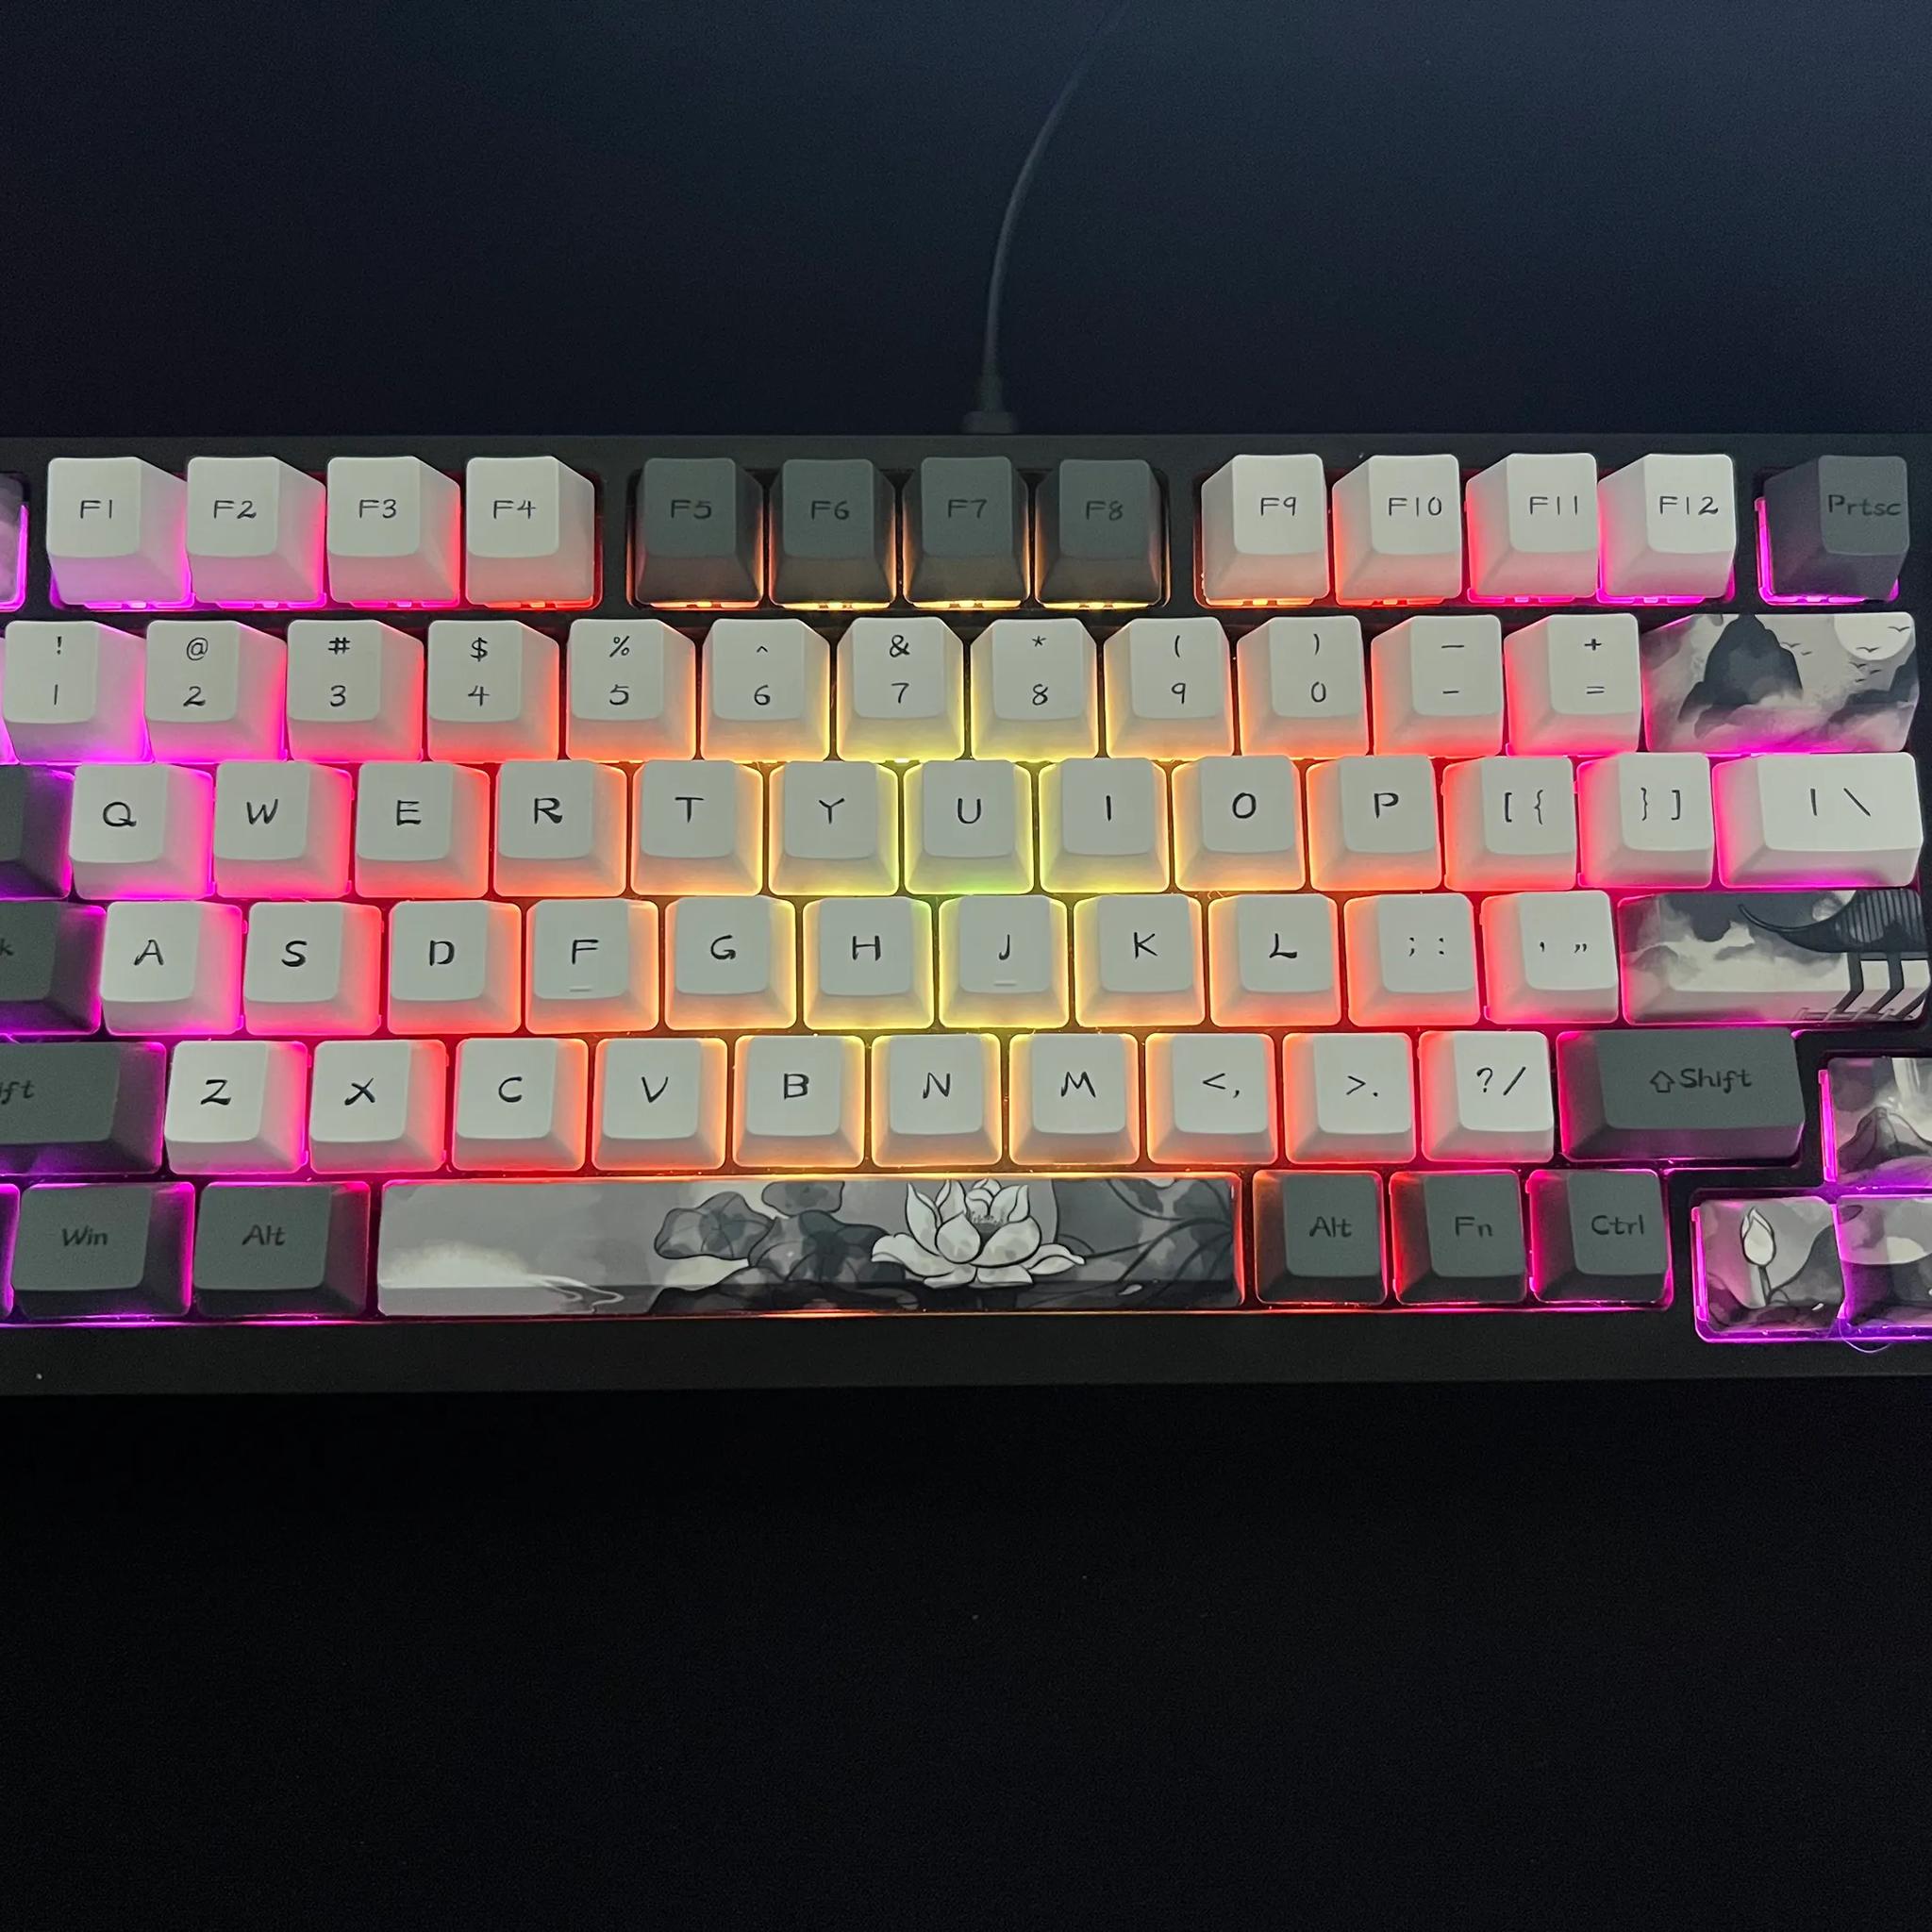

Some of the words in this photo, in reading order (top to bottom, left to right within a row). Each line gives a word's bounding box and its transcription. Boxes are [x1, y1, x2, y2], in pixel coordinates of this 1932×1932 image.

[79, 499, 113, 519] F1
[213, 499, 257, 520] F2
[358, 498, 397, 520] F3
[492, 500, 536, 520] F4
[670, 499, 712, 520] F5
[810, 500, 850, 521] F6
[947, 498, 988, 519] F7
[1085, 500, 1124, 522] F8
[1260, 496, 1297, 517] F9
[1388, 496, 1442, 517] F10
[1529, 495, 1578, 515] F11
[1659, 495, 1719, 516] F12
[1827, 493, 1901, 517] Prtsc
[57, 636, 62, 655] !
[186, 637, 208, 661] @
[327, 637, 351, 655] #
[471, 637, 488, 662] $
[608, 635, 630, 658] %
[889, 634, 910, 658] &
[1174, 635, 1180, 658] (
[1313, 633, 1321, 655] )
[1584, 638, 1602, 651] +
[183, 686, 206, 708] 2
[329, 684, 346, 708] 3
[467, 685, 490, 707] 4
[608, 684, 629, 706] 5
[754, 684, 771, 707] 6
[891, 682, 909, 704] 7
[1032, 683, 1049, 707] 8
[1171, 682, 1187, 705] 9
[1310, 681, 1327, 703] 0
[1586, 686, 1605, 695] =
[102, 801, 137, 827] Q
[246, 798, 278, 825] W
[396, 799, 422, 826] E
[534, 797, 563, 824] R
[675, 796, 704, 823] T
[818, 797, 845, 824] Y
[957, 797, 982, 824] U
[1106, 794, 1112, 822] I
[1232, 791, 1257, 820] O
[1374, 792, 1399, 819] P
[133, 939, 164, 966] A
[281, 940, 308, 968] S
[428, 940, 455, 967] D
[571, 939, 599, 965] F
[709, 934, 737, 960] G
[852, 935, 881, 961] H
[998, 934, 1010, 961] J
[1133, 931, 1158, 958] K
[1269, 933, 1298, 959] L
[200, 1078, 231, 1106] Z
[343, 1078, 375, 1107] X
[498, 1076, 523, 1104] C
[641, 1076, 669, 1104] V
[783, 1073, 809, 1100] B
[922, 1072, 951, 1100] N
[1060, 1071, 1096, 1098] M
[1679, 1067, 1753, 1095] Shift
[61, 1225, 108, 1247] Win
[242, 1224, 285, 1246] Alt
[1308, 1216, 1352, 1238] Alt
[1455, 1216, 1493, 1238] Fn
[1591, 1214, 1644, 1236] Ctrl
